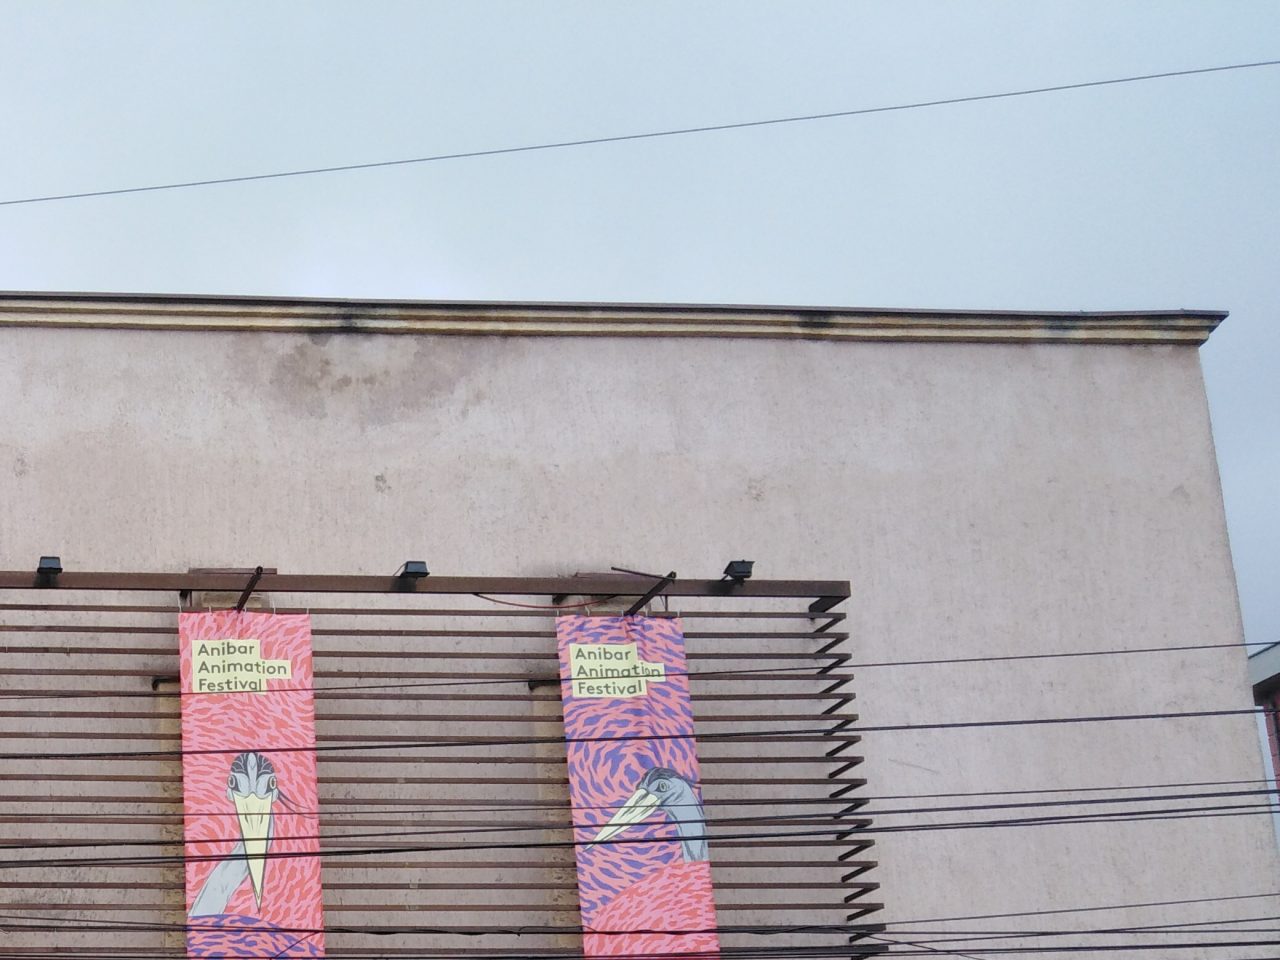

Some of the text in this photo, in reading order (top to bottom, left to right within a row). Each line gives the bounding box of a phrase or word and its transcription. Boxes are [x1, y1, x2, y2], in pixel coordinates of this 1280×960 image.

[197, 642, 255, 656] Anibar
[575, 647, 632, 661] Anibar
[197, 660, 288, 675] Animation
[576, 662, 661, 678] Animation
[198, 677, 262, 692] Festival
[578, 680, 643, 695] Festival
